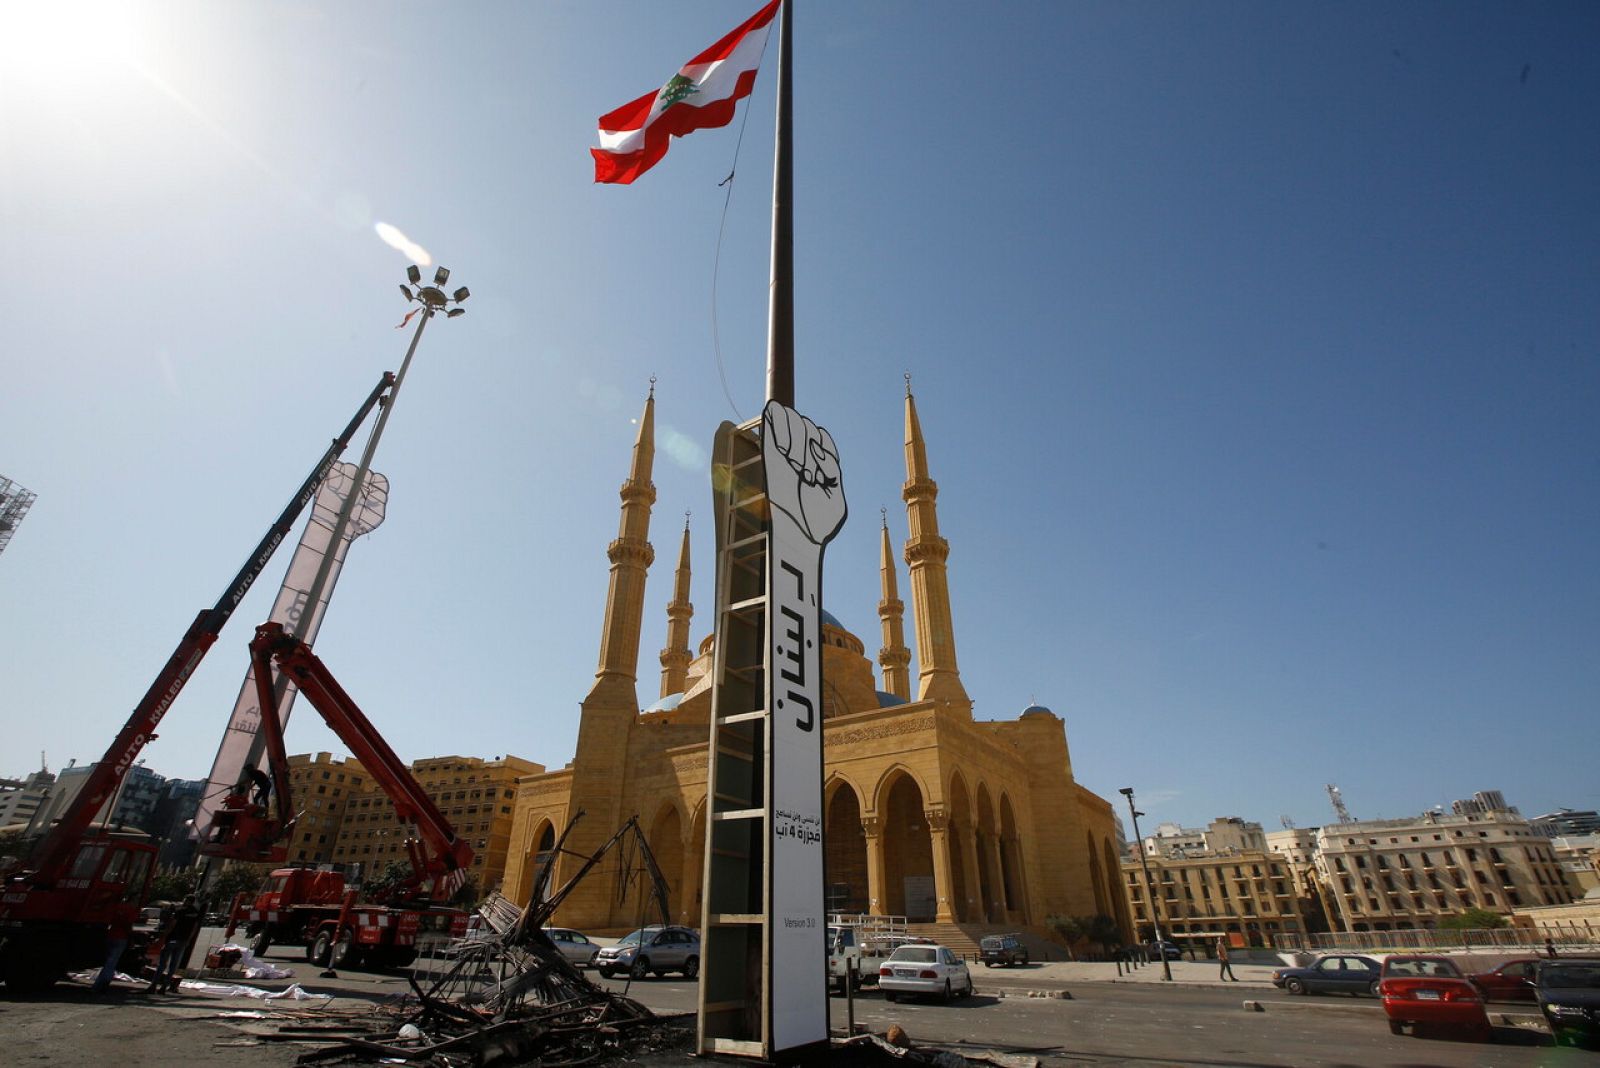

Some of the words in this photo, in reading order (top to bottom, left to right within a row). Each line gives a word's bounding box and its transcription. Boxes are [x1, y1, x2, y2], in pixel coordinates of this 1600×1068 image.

[301, 480, 318, 506] AUTO
[232, 573, 254, 605] AUTO
[114, 733, 145, 776] AUTO
[149, 678, 182, 725] KHALED
[789, 825, 796, 838] 4
[784, 917, 806, 929] Version
